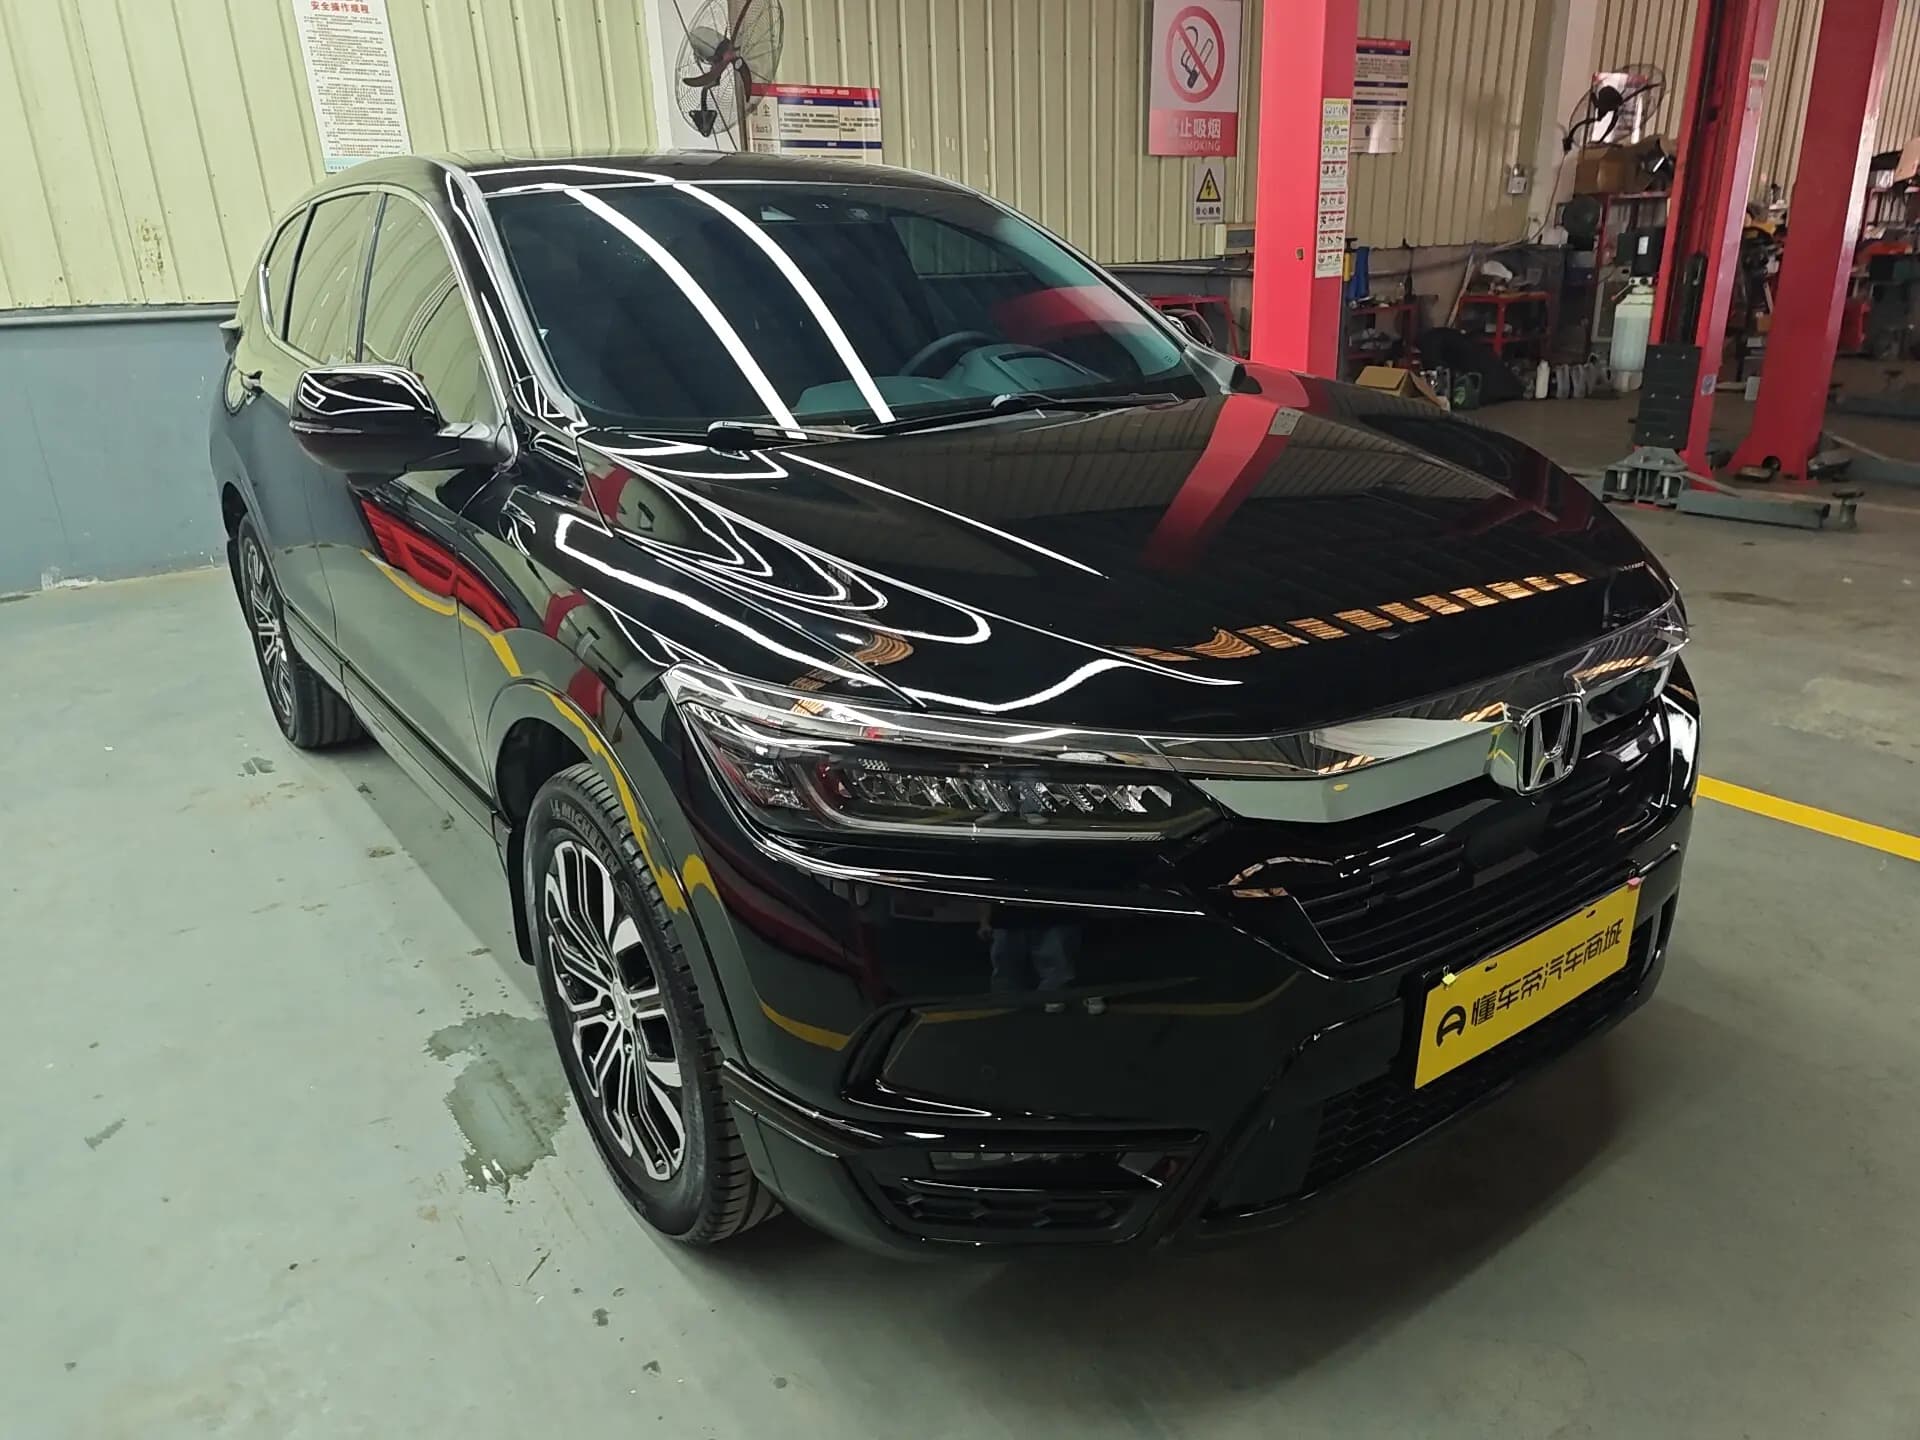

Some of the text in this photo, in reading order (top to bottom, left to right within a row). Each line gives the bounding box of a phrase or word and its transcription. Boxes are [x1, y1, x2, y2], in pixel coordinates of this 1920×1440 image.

[1168, 116, 1222, 139] 止吸烟
[1470, 918, 1625, 1027] 懂车帝汽车商城
